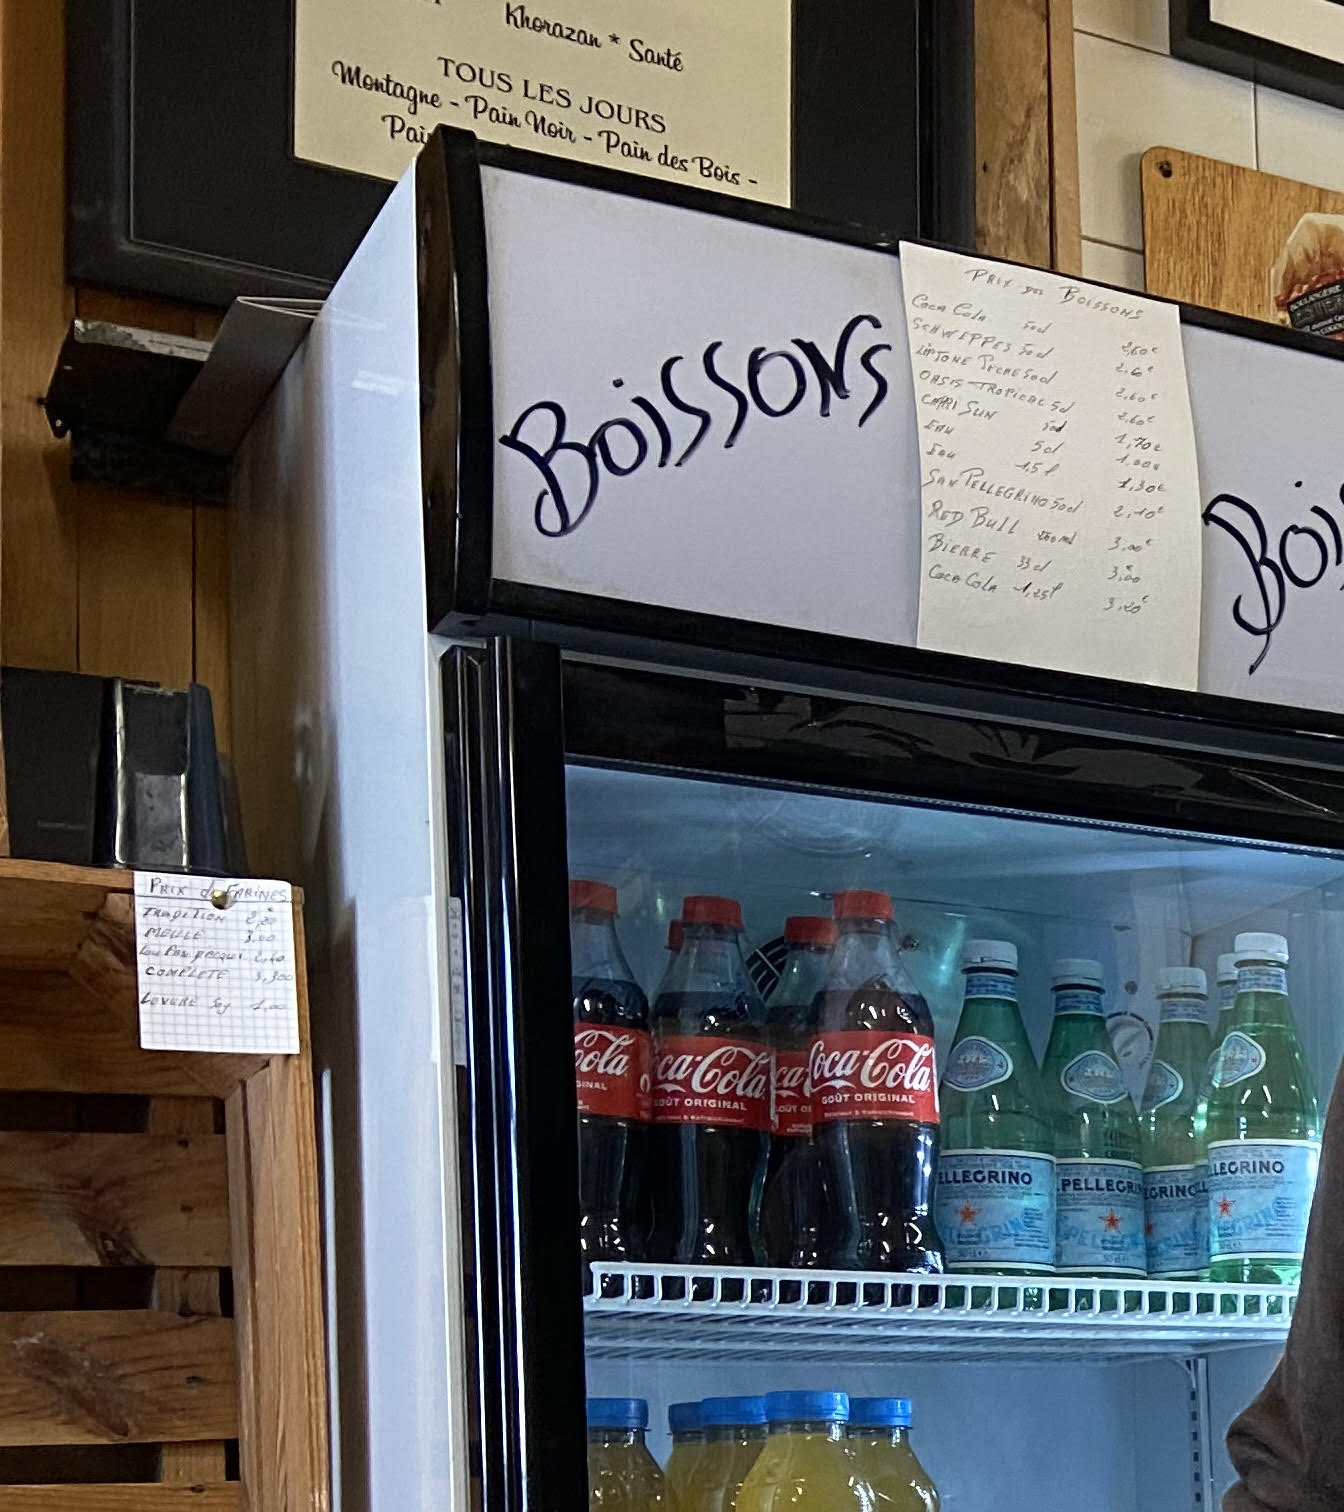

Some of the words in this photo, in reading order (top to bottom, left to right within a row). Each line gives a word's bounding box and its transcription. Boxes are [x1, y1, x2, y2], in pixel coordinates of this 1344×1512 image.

[505, 5, 601, 49] Khorazan
[629, 38, 684, 73] Santé
[332, 60, 442, 115] Montagne
[465, 95, 522, 128] Pain
[526, 110, 576, 145] Noir
[599, 129, 653, 163] Pain
[657, 144, 689, 173] des
[692, 156, 740, 187] Bois
[437, 57, 513, 93] TOUS
[523, 79, 572, 109] LES
[580, 96, 666, 135] JOURS
[381, 114, 431, 145] Pai
[149, 877, 187, 897] PRIX
[803, 1037, 932, 1098] Coca-Cola
[854, 1093, 916, 1105] ORIGINAL
